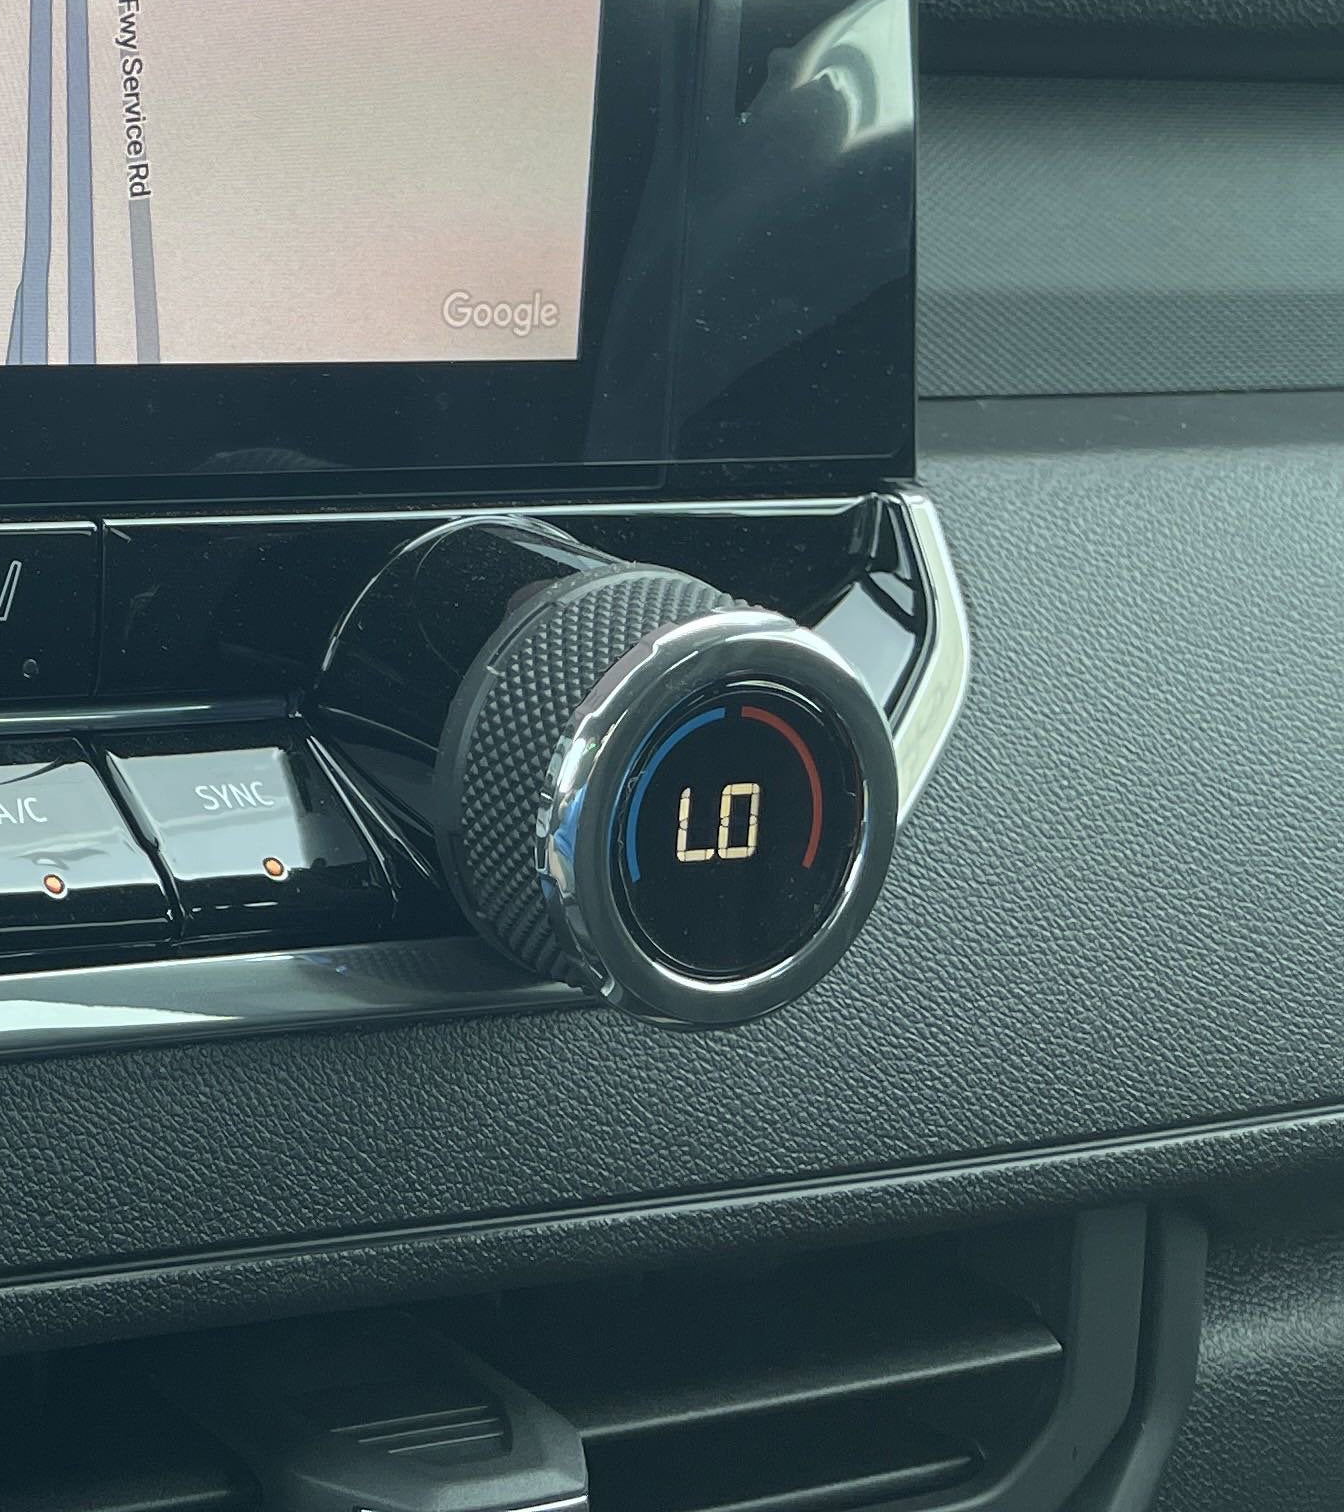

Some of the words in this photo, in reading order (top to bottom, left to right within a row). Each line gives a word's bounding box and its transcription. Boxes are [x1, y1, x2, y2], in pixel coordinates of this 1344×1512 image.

[121, 57, 145, 157] Service
[127, 162, 152, 199] Rd
[442, 291, 560, 338] Google
[194, 779, 275, 813] SYNC
[676, 782, 762, 863] LO
